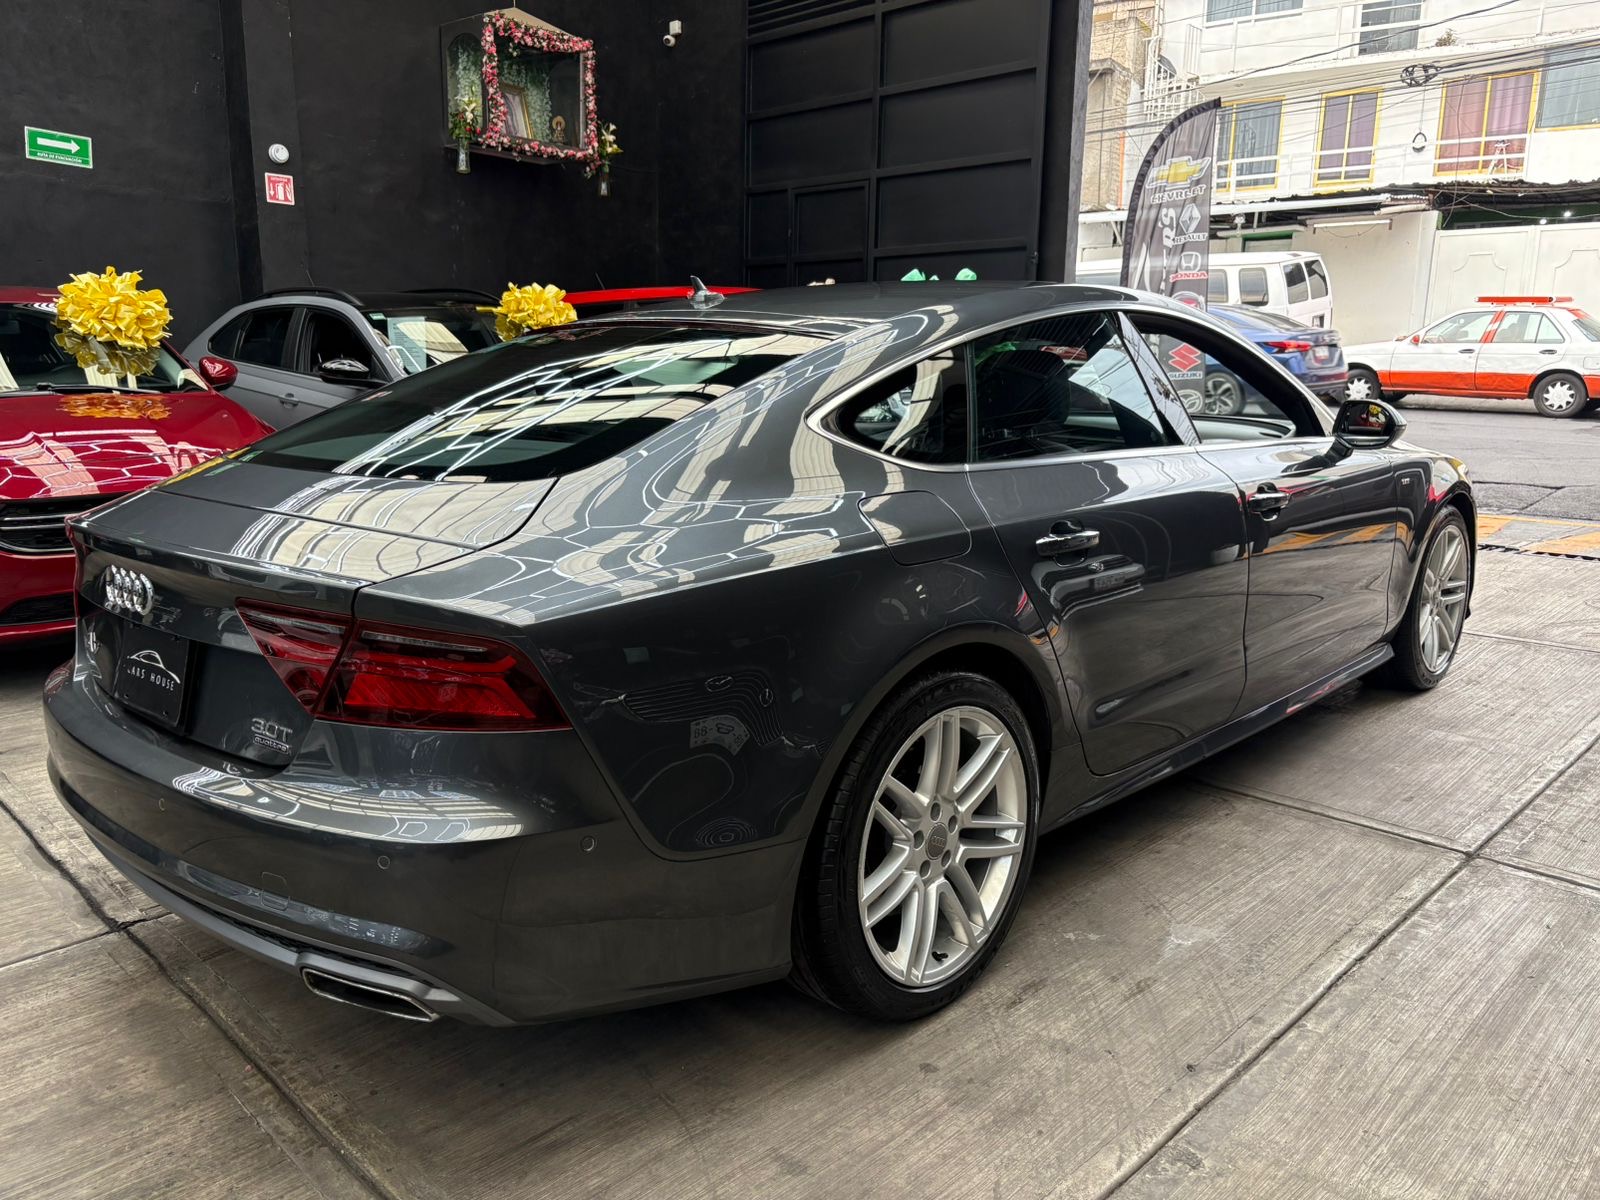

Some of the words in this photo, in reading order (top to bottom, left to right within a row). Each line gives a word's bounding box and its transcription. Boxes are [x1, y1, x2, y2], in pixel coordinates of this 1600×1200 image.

[1168, 370, 1203, 380] SUZUKI
[150, 672, 175, 692] HOUSE
[254, 736, 288, 753] quattro
